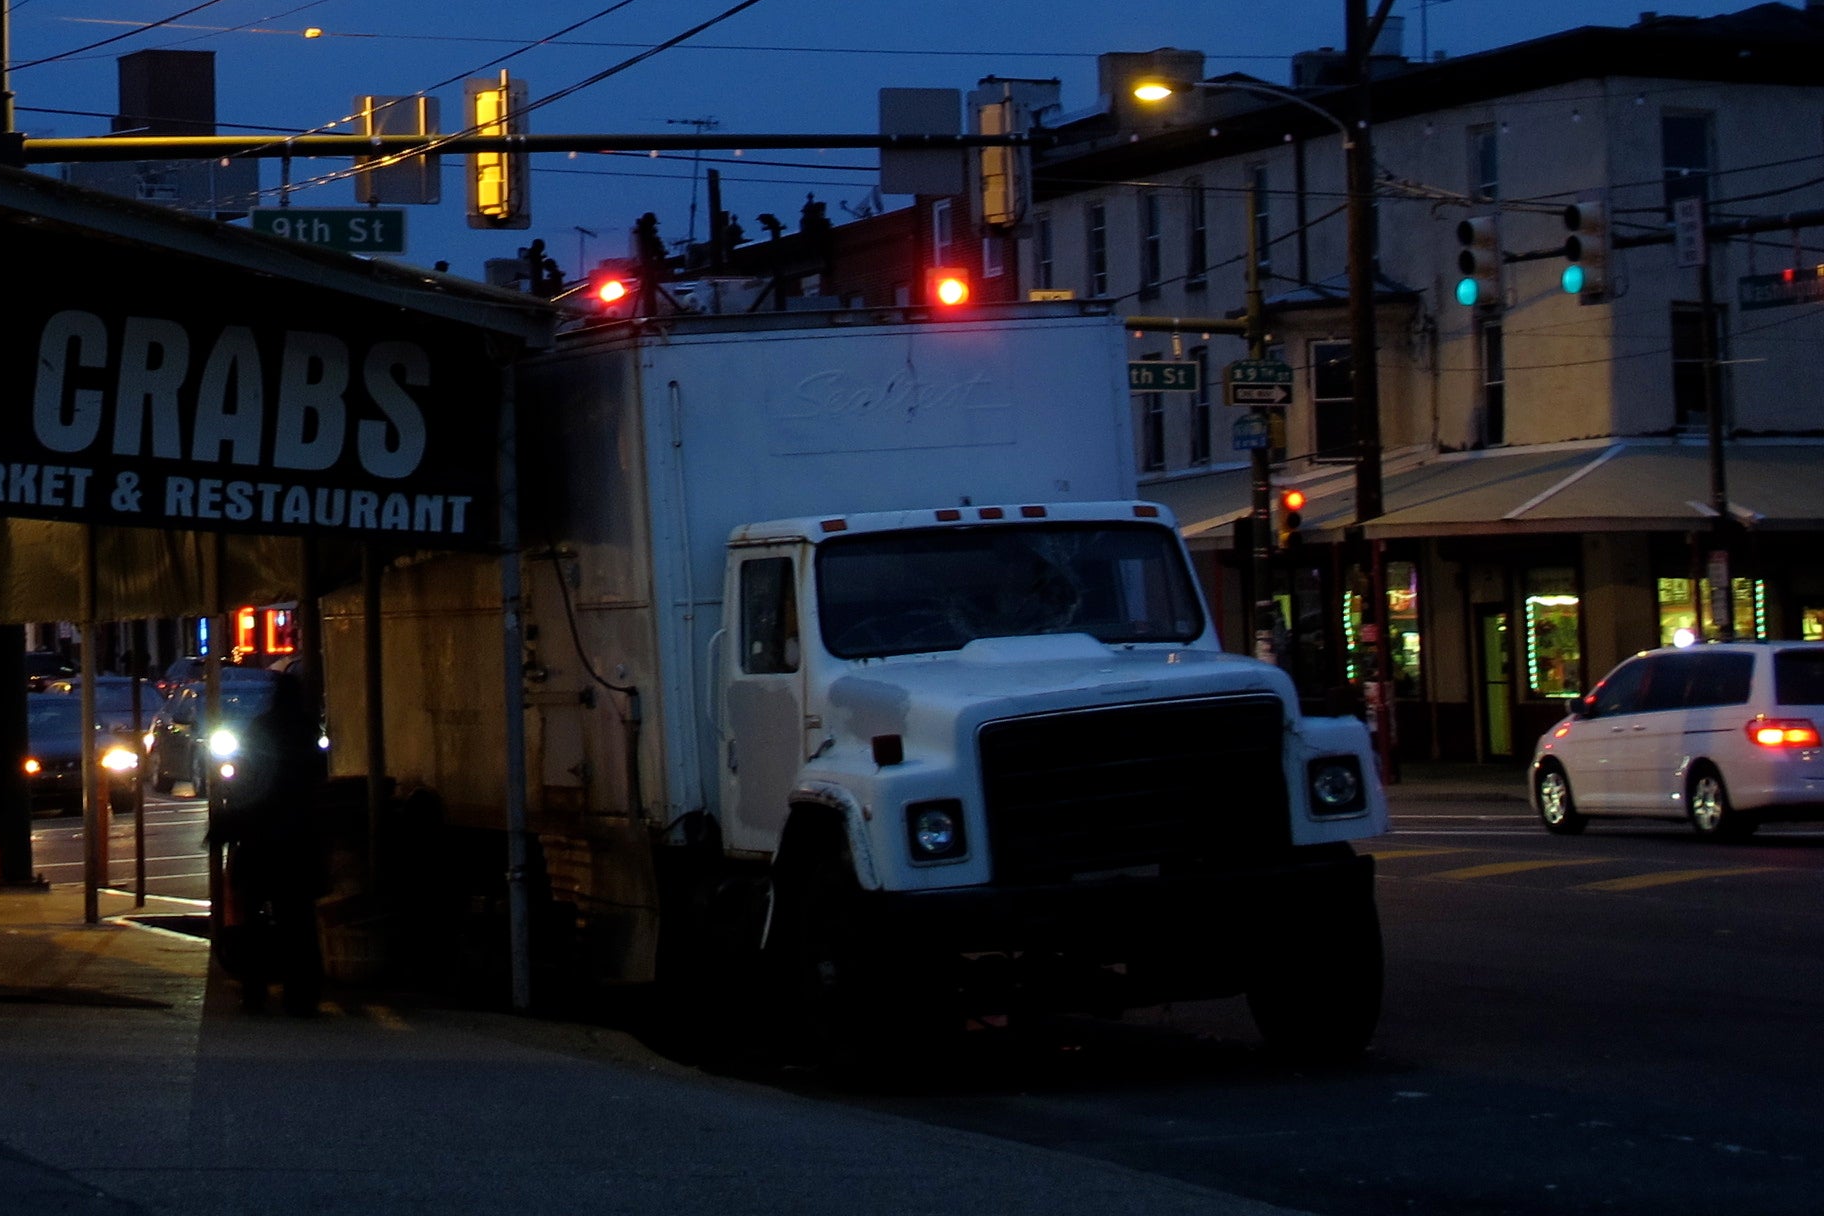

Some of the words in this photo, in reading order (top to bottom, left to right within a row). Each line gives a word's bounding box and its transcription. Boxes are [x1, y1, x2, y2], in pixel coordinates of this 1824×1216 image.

[271, 216, 332, 243] 9th
[348, 217, 385, 243] St
[31, 308, 432, 480] CRABS
[1130, 366, 1155, 385] th
[1162, 367, 1187, 385] St
[109, 469, 144, 513] &
[163, 474, 475, 535] RESTAURANT
